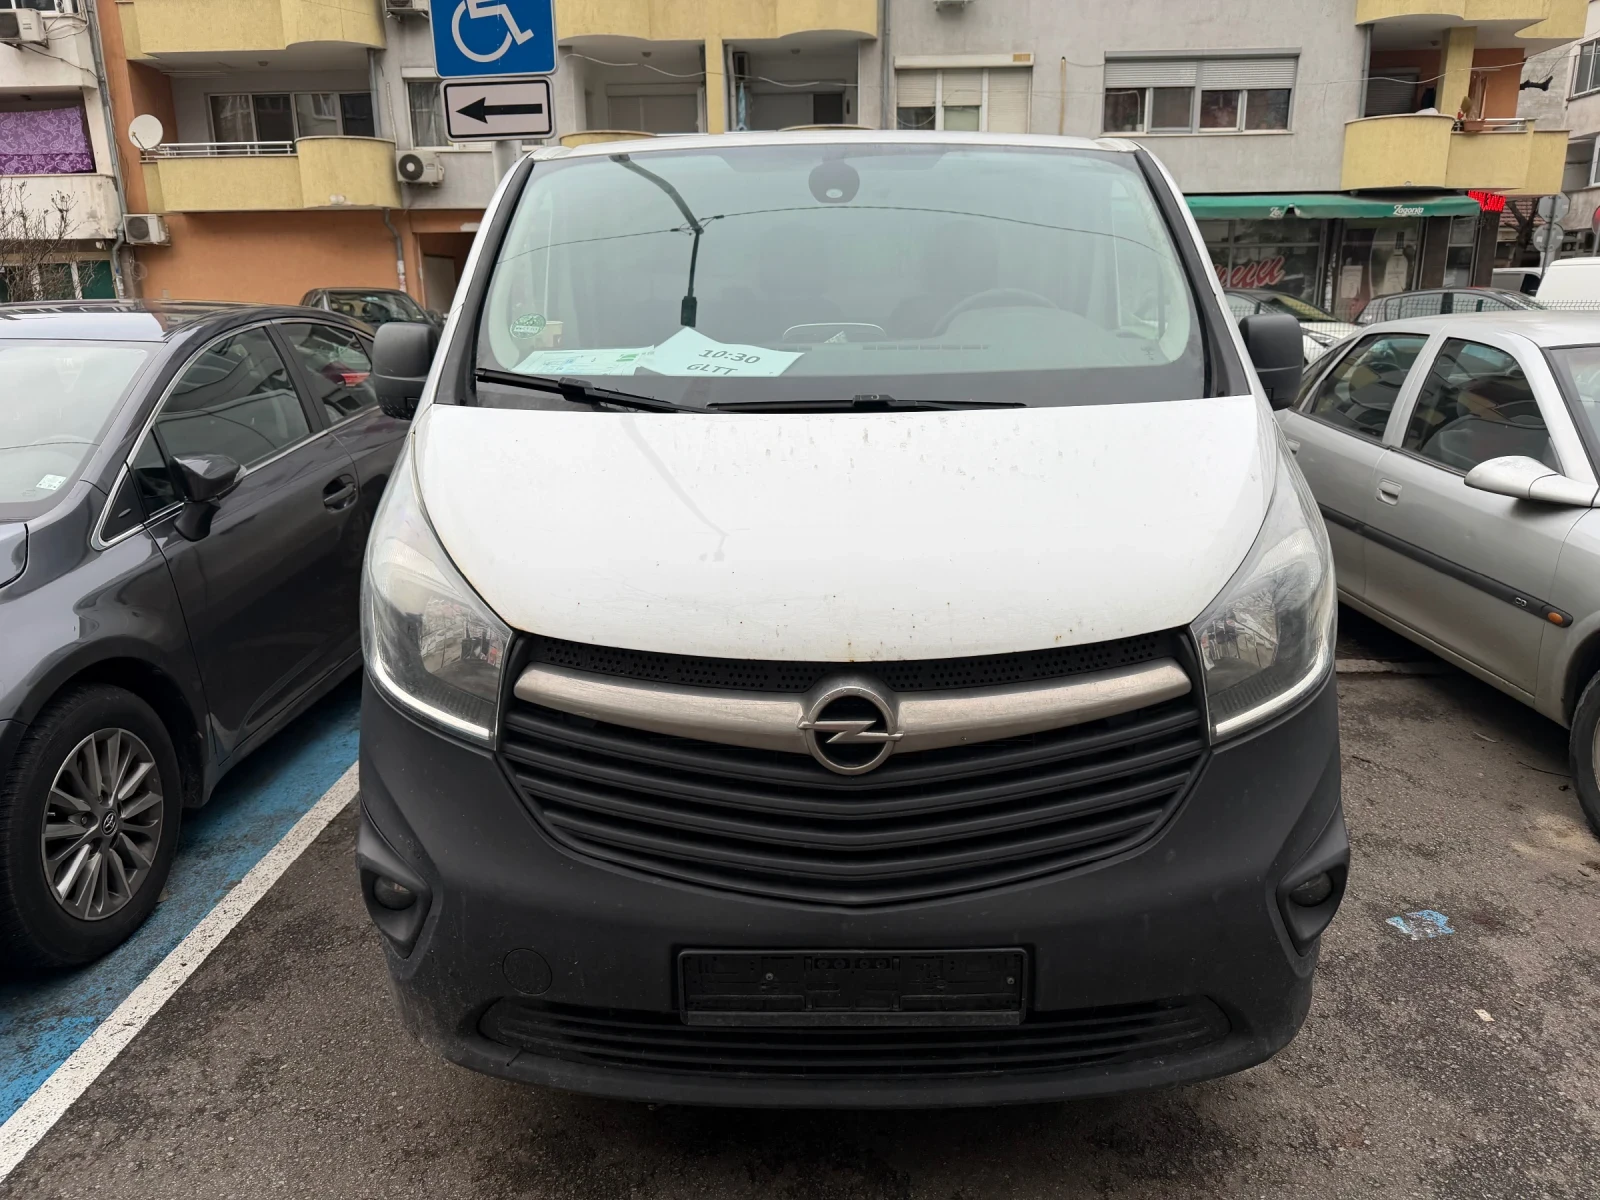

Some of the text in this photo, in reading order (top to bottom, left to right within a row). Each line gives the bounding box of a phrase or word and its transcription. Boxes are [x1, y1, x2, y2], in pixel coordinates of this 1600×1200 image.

[1393, 204, 1425, 217] Zagorka
[698, 349, 761, 364] 10:30
[686, 363, 739, 376] GLTT
